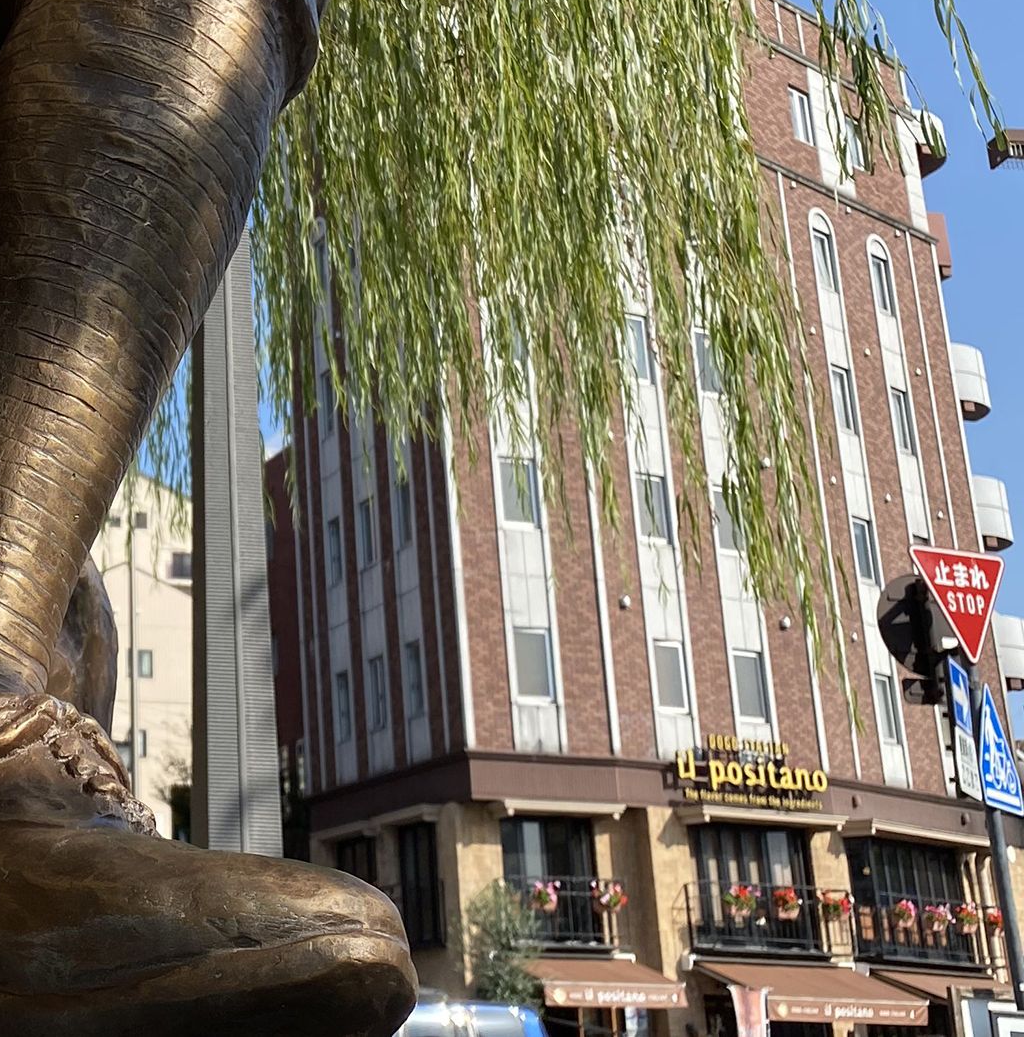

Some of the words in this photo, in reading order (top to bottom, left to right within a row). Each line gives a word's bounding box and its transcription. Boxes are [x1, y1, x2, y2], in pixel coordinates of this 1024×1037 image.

[934, 558, 990, 590] 止まれ
[947, 590, 985, 616] STOP
[709, 756, 828, 793] positano
